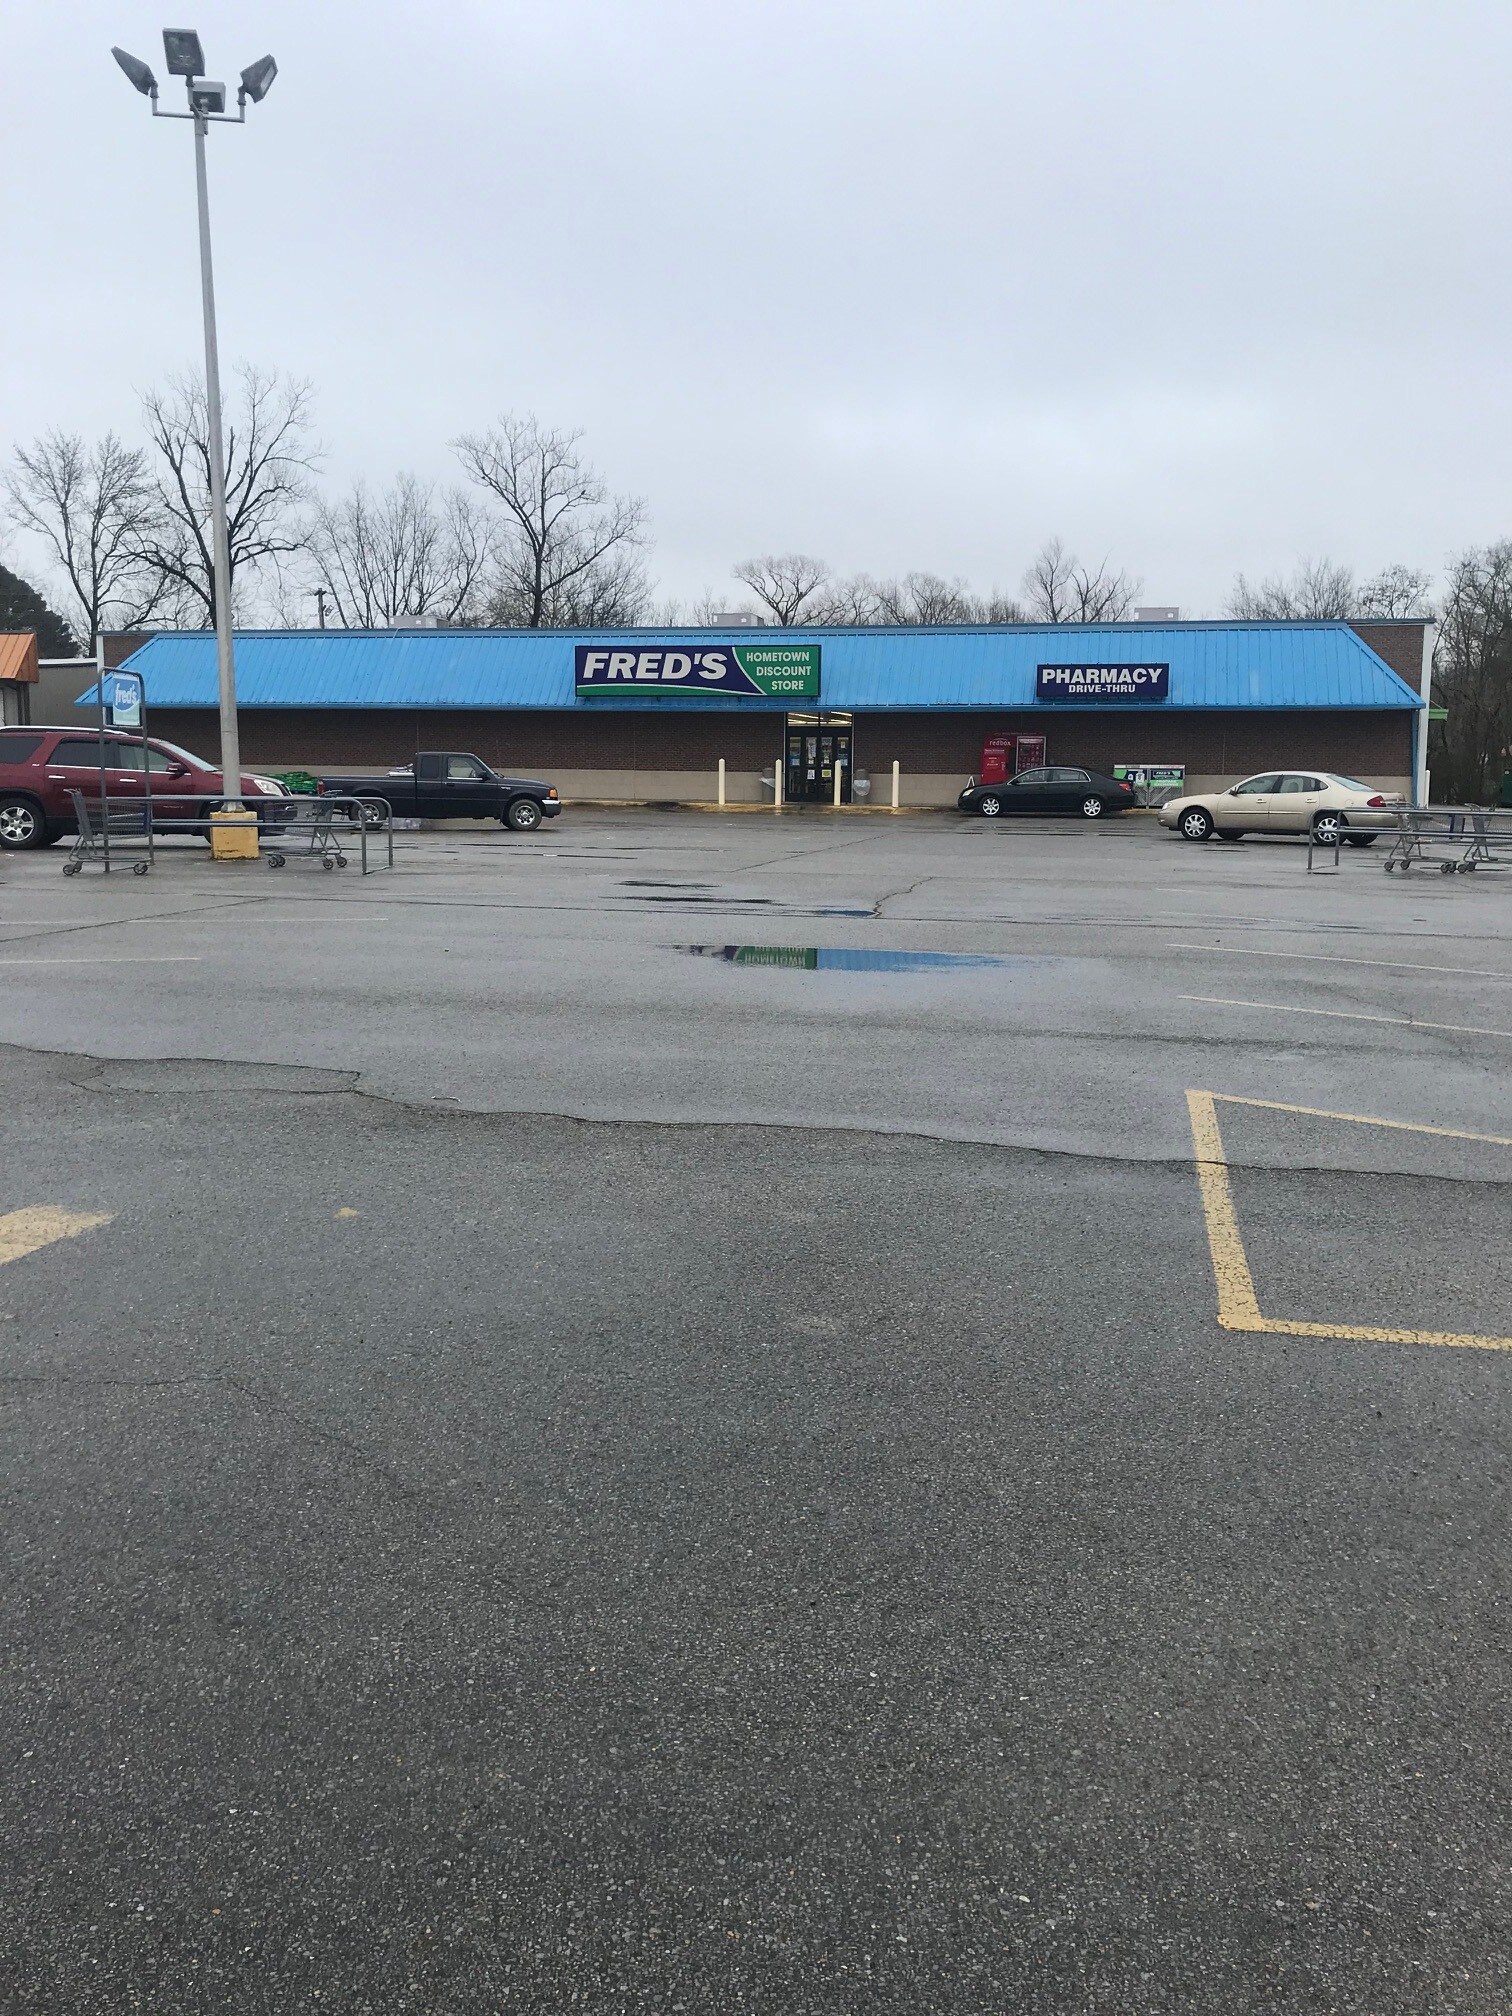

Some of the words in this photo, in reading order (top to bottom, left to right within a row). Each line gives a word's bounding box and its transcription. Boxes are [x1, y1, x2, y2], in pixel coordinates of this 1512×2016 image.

[746, 652, 810, 662] HOMETOWN
[583, 652, 728, 680] FRED'S
[756, 666, 811, 676] DISCOUNT
[1042, 668, 1163, 684] PHARMACY
[771, 681, 804, 690] STORE
[1068, 684, 1136, 693] DRIVE-THRU
[115, 683, 137, 706] fred's
